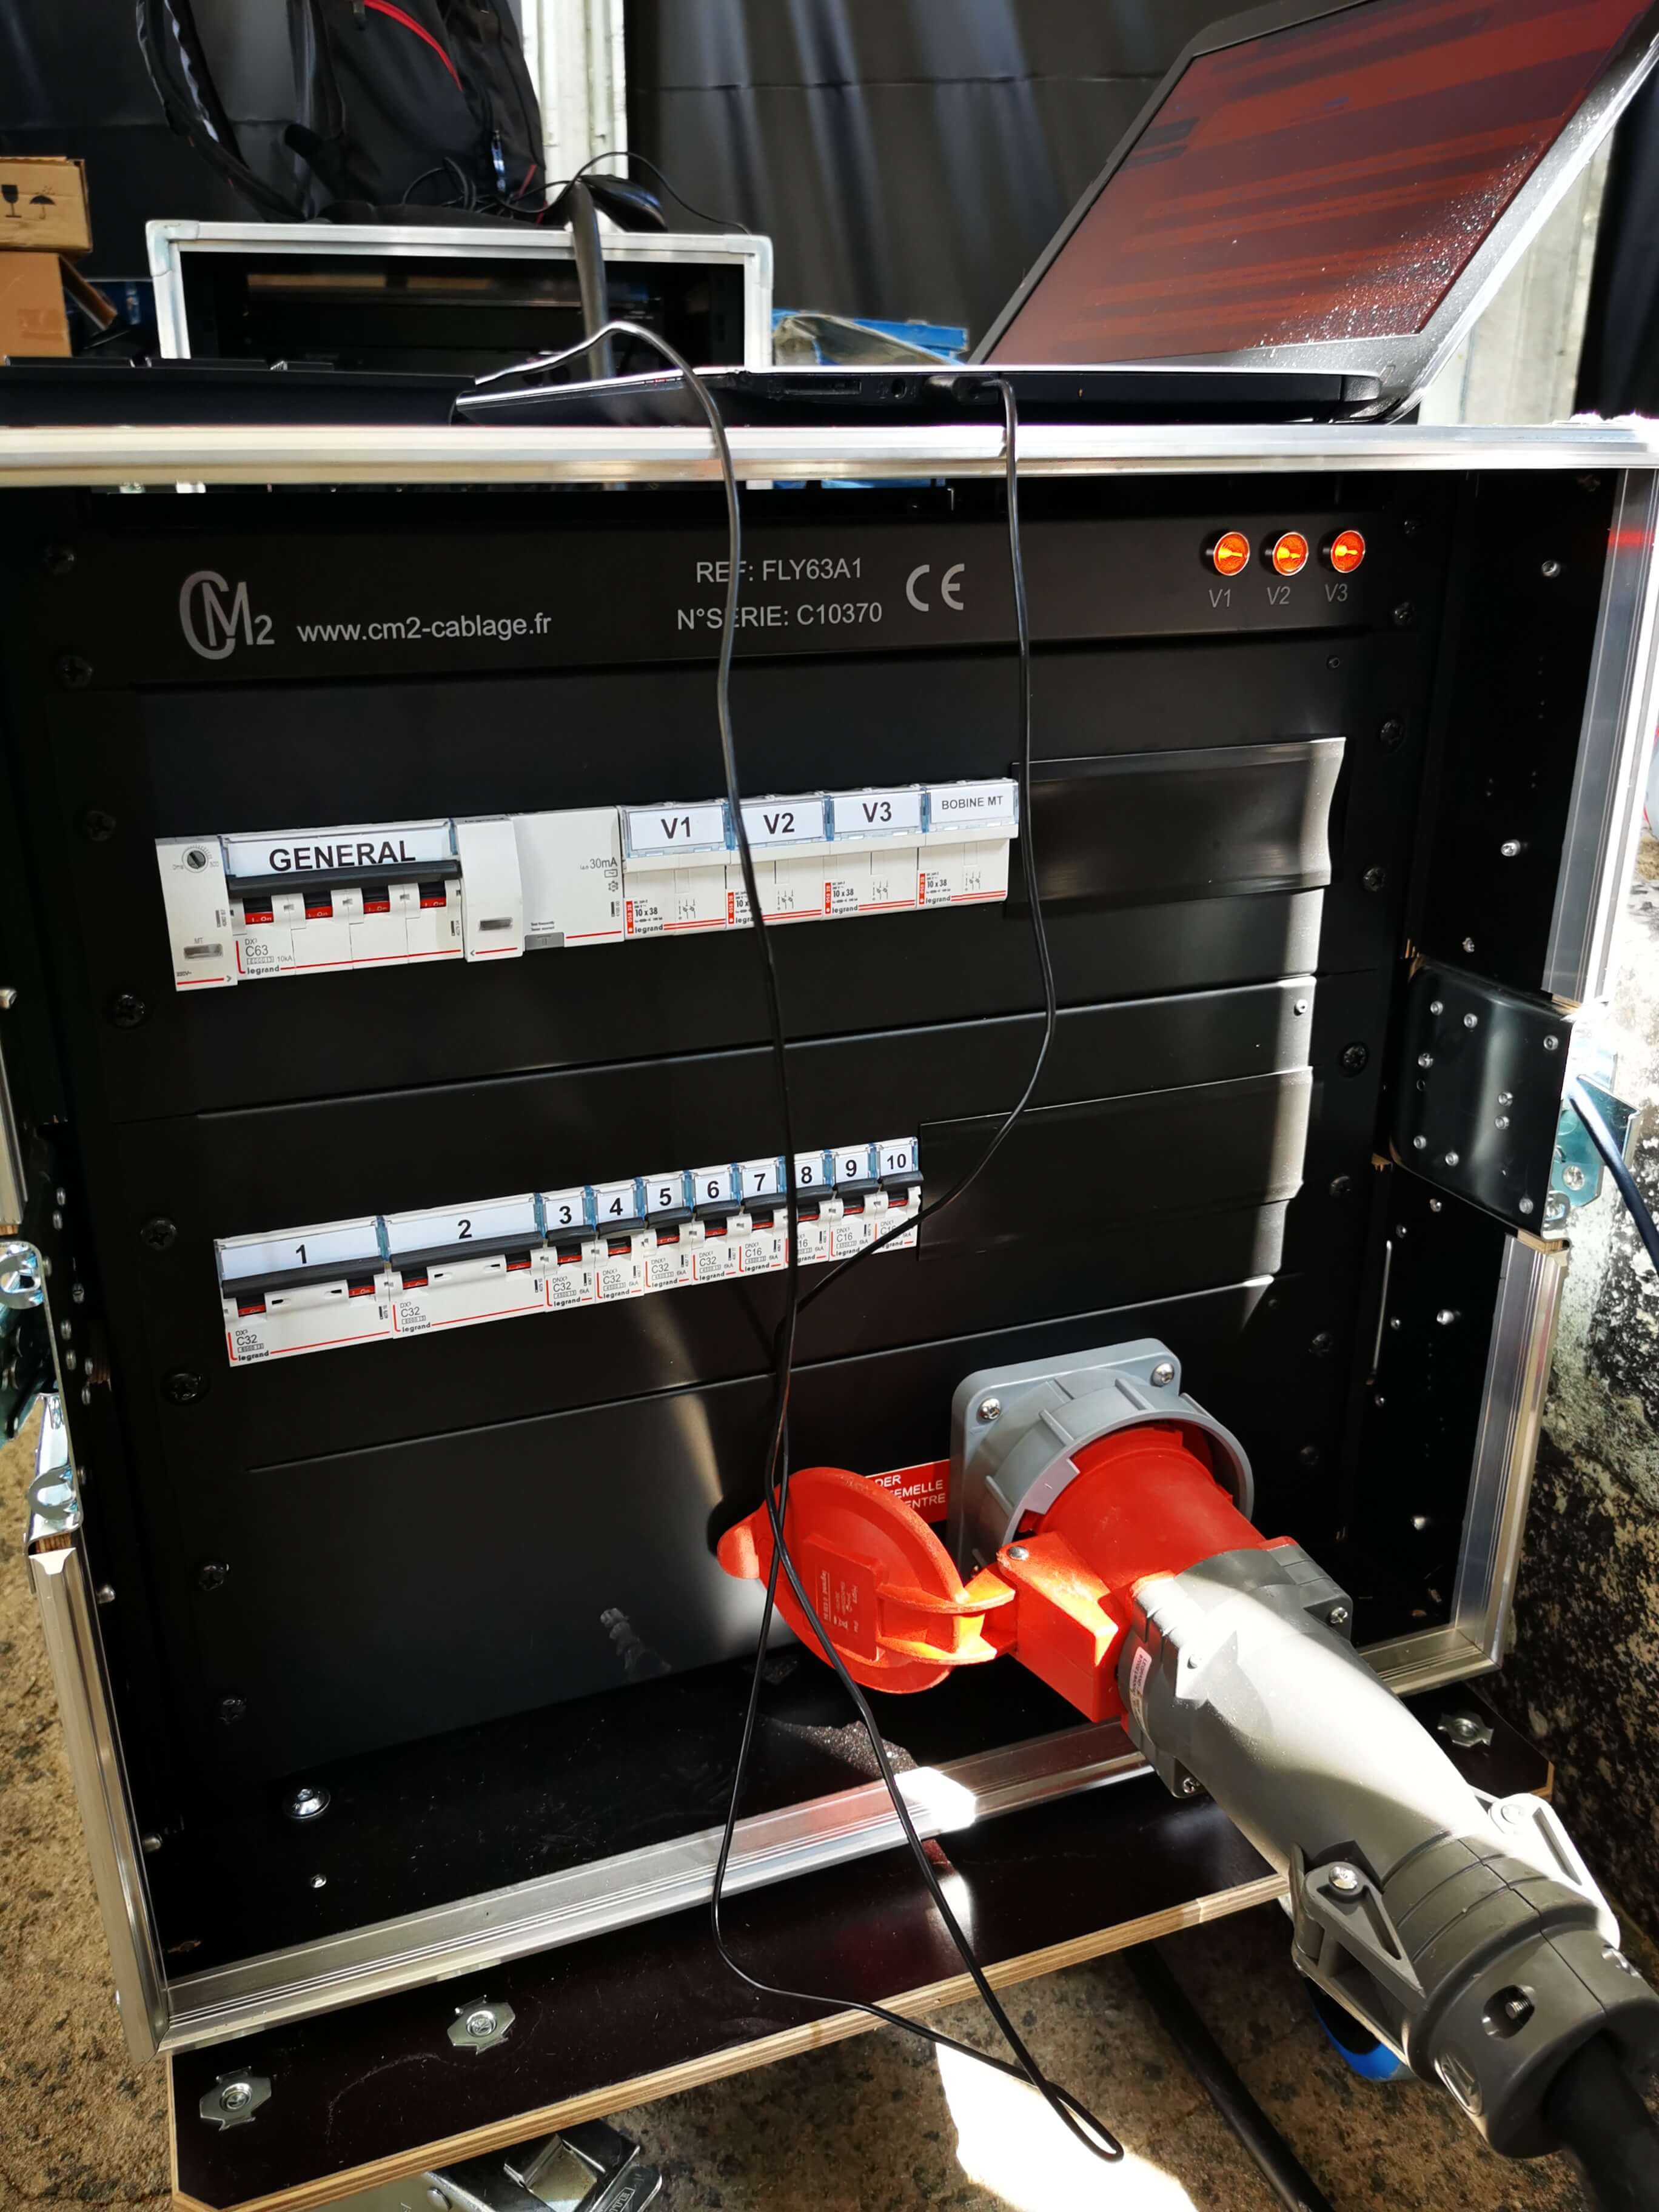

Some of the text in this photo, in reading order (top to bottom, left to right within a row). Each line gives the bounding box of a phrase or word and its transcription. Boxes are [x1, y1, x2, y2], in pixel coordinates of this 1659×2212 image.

[762, 557, 862, 581] FLY63A1
[1208, 588, 1231, 608] V1
[1267, 586, 1291, 605] V2
[1325, 583, 1348, 602] V3
[797, 602, 883, 626] C10370
[297, 612, 552, 642] www.cm2-cablage.fr
[942, 796, 1003, 810] BOBINE MT
[862, 801, 892, 823] V3
[661, 816, 691, 840] V1
[763, 813, 795, 835] V2
[269, 840, 416, 872] GENERAL
[589, 857, 618, 870] 30mA
[926, 896, 950, 904] legrand
[635, 908, 643, 917] 10
[832, 905, 858, 913] legrand
[635, 924, 663, 933] legrand
[246, 945, 268, 956] C63
[247, 967, 280, 975] legrand
[886, 1153, 907, 1170] 10
[845, 1160, 857, 1178] 9
[801, 1166, 813, 1184] 8
[754, 1173, 766, 1191] 7
[707, 1181, 720, 1199] 6
[659, 1188, 672, 1206] 5
[609, 1198, 623, 1216] 4
[559, 1205, 572, 1224] 3
[457, 1219, 472, 1239] 2
[837, 1233, 853, 1242] C16
[799, 1239, 808, 1248] 16
[882, 1241, 903, 1249] grand
[295, 1244, 307, 1264] 1
[745, 1248, 762, 1258] C16
[836, 1247, 860, 1257] legrand
[699, 1256, 717, 1267] C32
[797, 1254, 816, 1263] grand
[651, 1264, 669, 1274] C32
[745, 1263, 770, 1272] legrand
[603, 1275, 621, 1285] C32
[699, 1271, 725, 1281] legrand
[553, 1281, 571, 1292] C32
[652, 1278, 678, 1288] legrand
[603, 1290, 630, 1299] legrand
[554, 1297, 580, 1307] legrand
[401, 1307, 420, 1318] C32
[402, 1322, 431, 1333] legrand
[236, 1335, 257, 1346] C32
[238, 1350, 269, 1362] legrand
